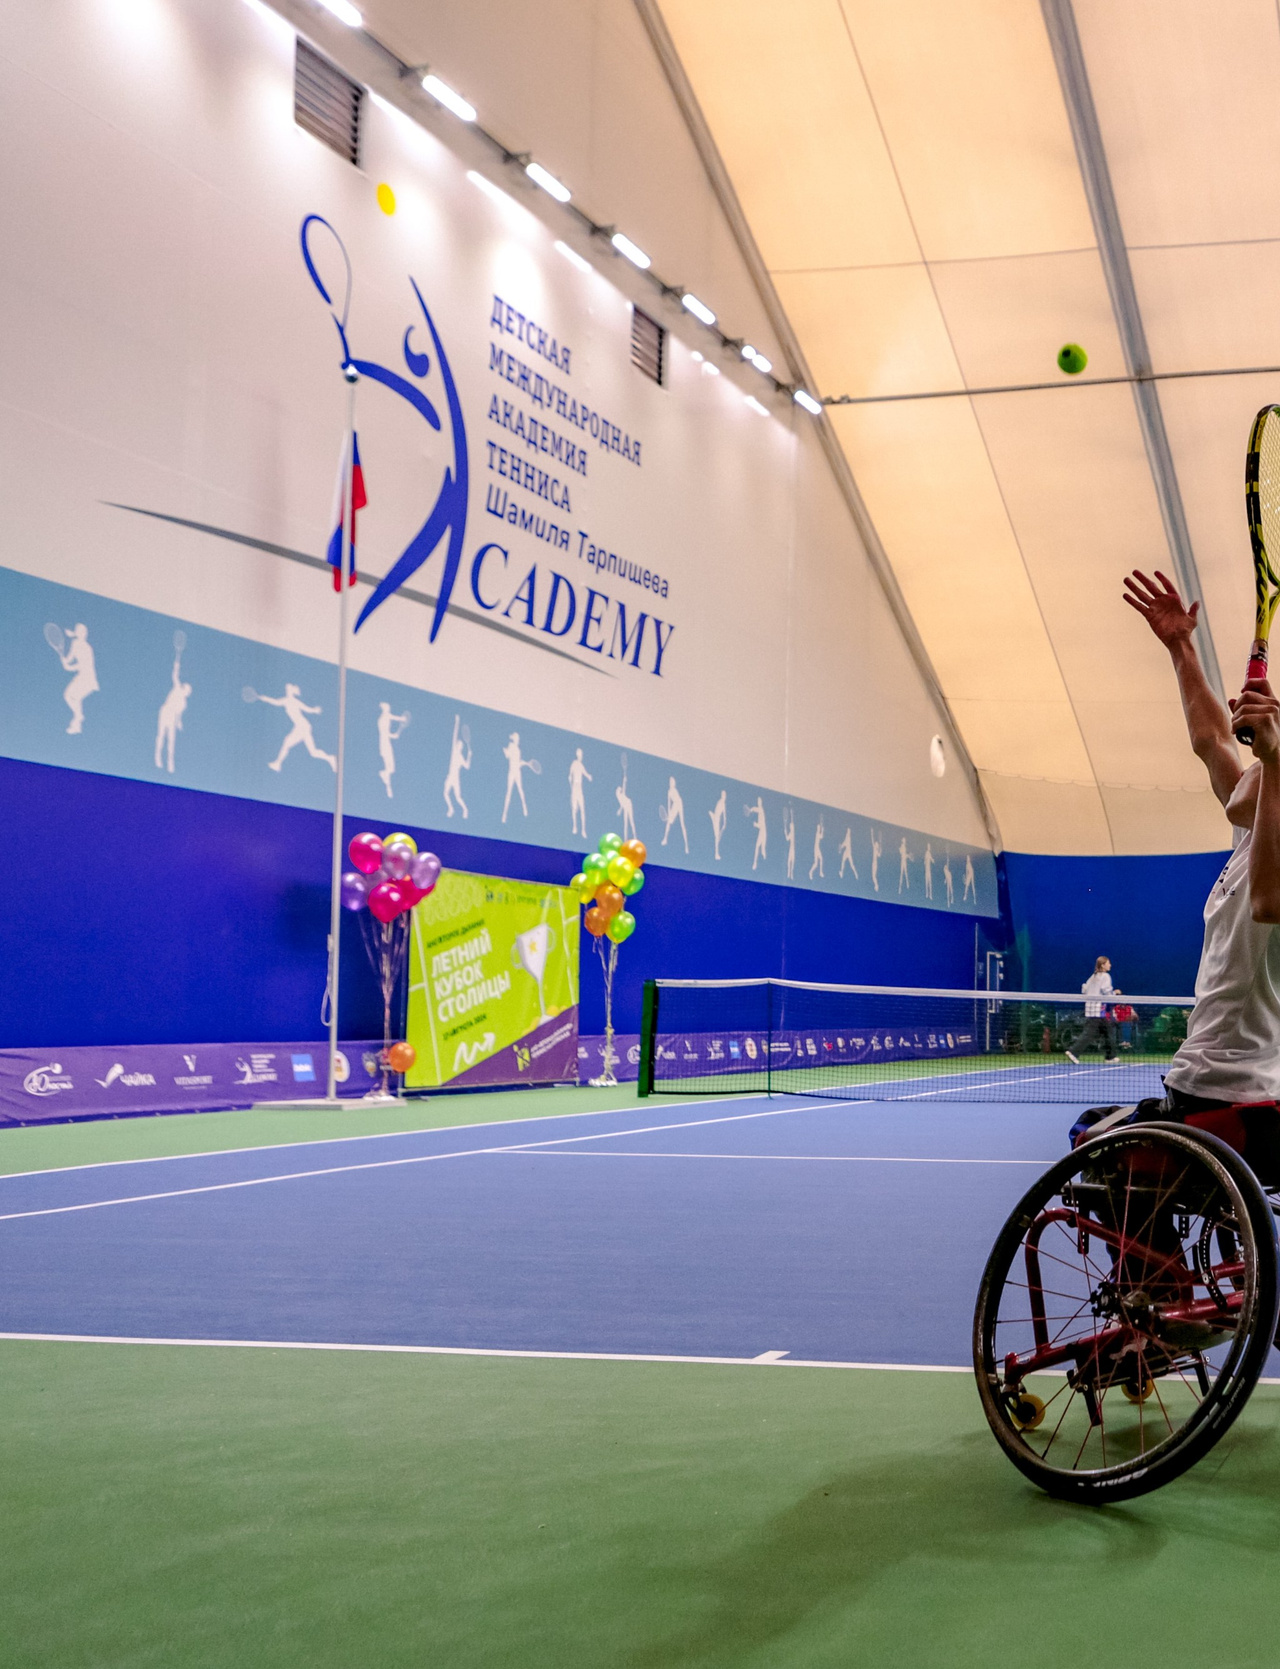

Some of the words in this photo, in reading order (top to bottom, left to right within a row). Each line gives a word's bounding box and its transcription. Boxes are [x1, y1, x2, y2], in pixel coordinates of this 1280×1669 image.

[490, 294, 572, 375] ДЕТСКАЯ
[487, 393, 588, 477] АКАДЕМИЯ
[488, 342, 642, 467] МЕЖДУНАРОДНАЯ
[486, 440, 573, 514] ТЕННИСА
[486, 483, 570, 552] Шамиля
[432, 927, 493, 978] ЛЕТНИЙ
[434, 959, 485, 1001] КУБОК
[437, 970, 512, 1023] СТОЛИЦЫ
